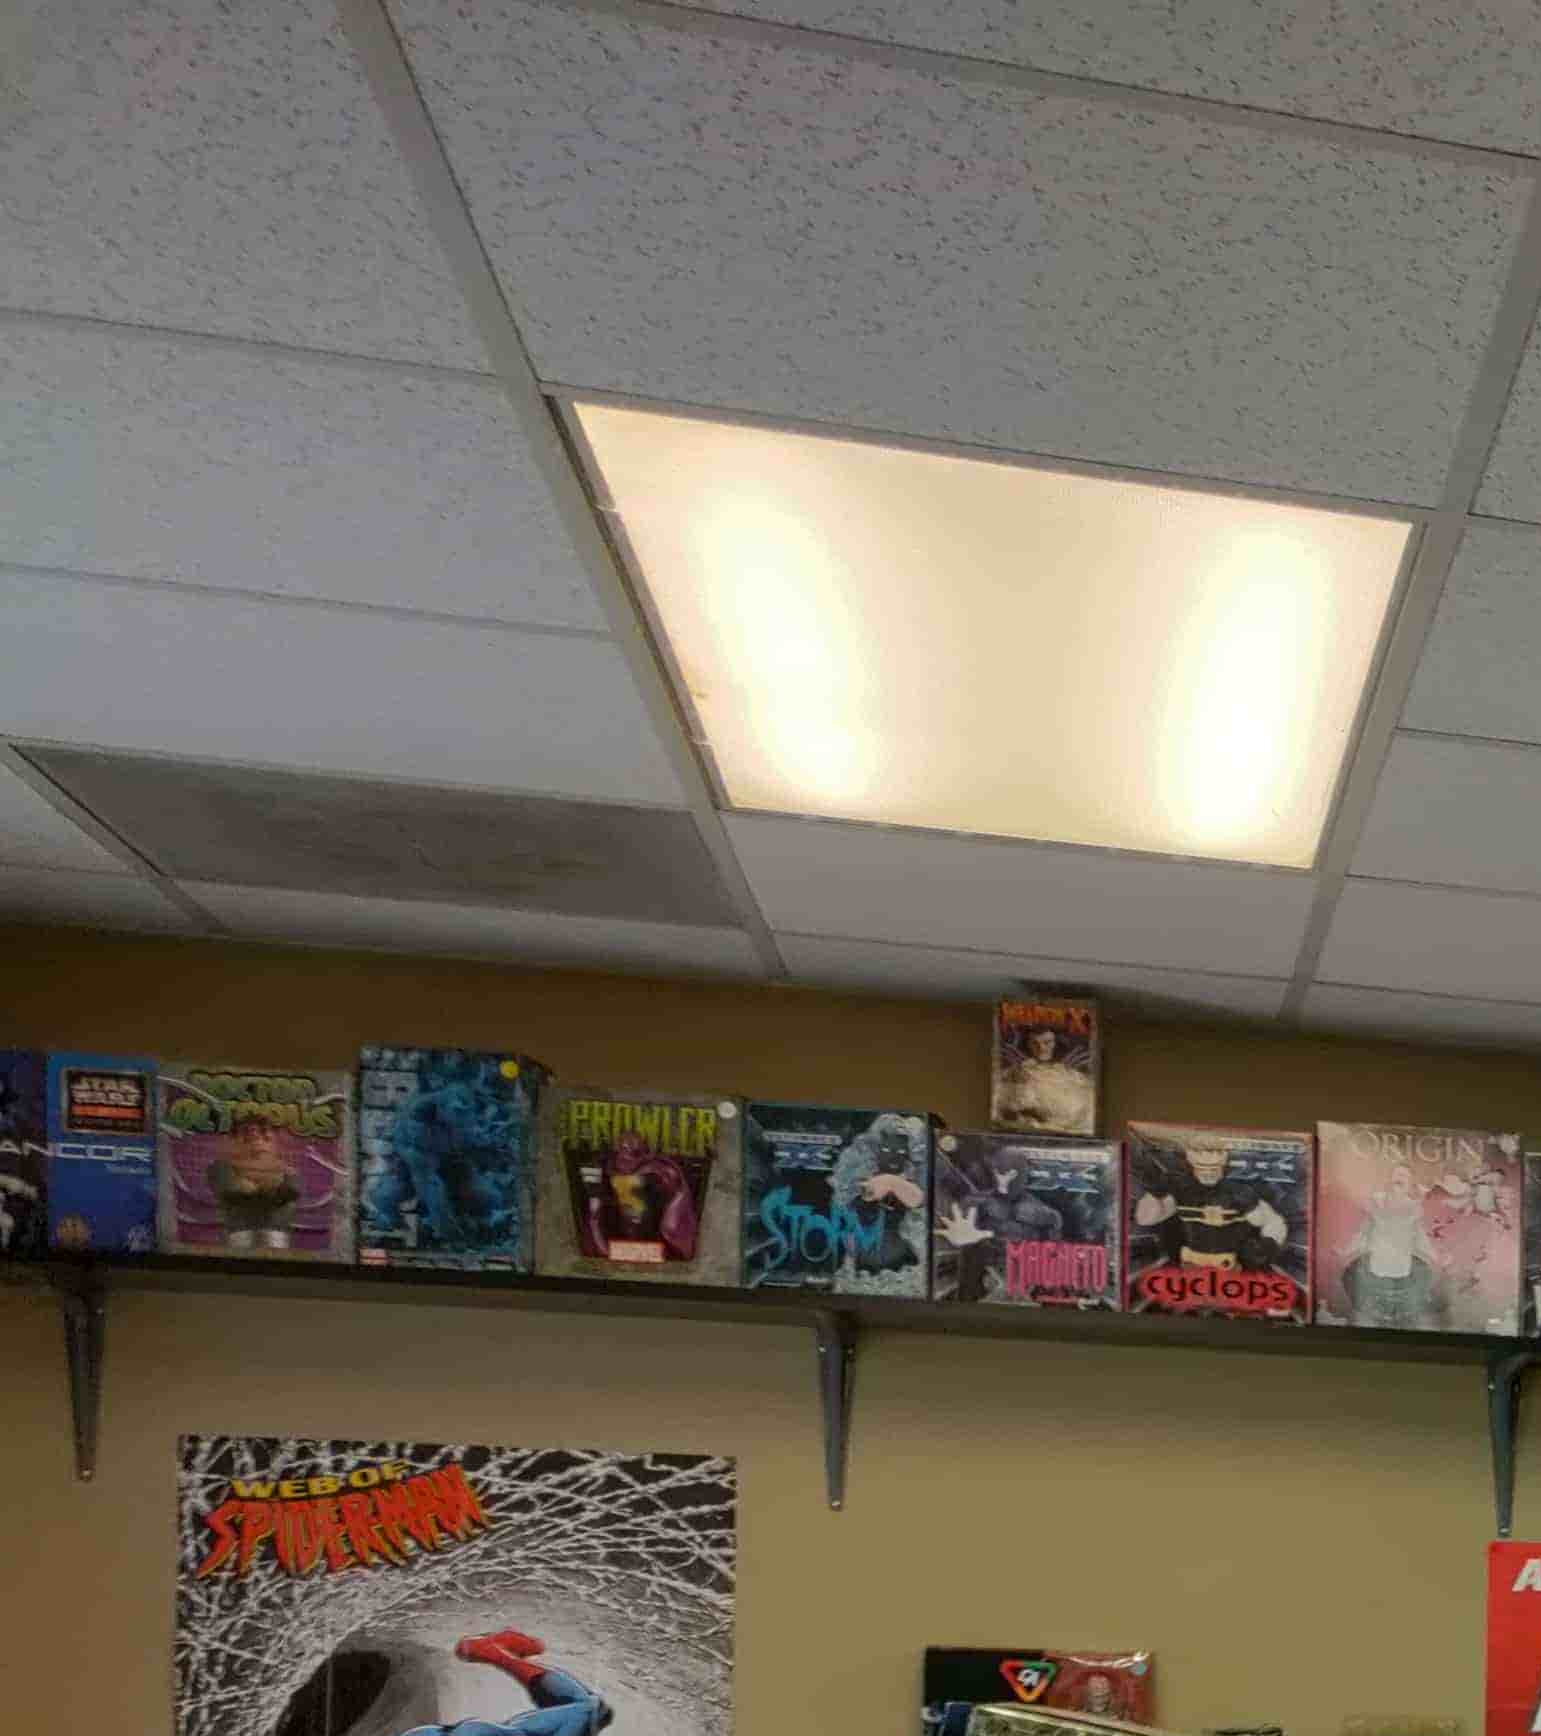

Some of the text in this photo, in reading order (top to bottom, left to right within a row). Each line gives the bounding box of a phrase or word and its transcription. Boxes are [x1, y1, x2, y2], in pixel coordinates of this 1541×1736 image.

[566, 1100, 717, 1155] PROWLER
[1350, 1126, 1488, 1165] ORIGIN
[231, 1461, 409, 1499] WEB OF
